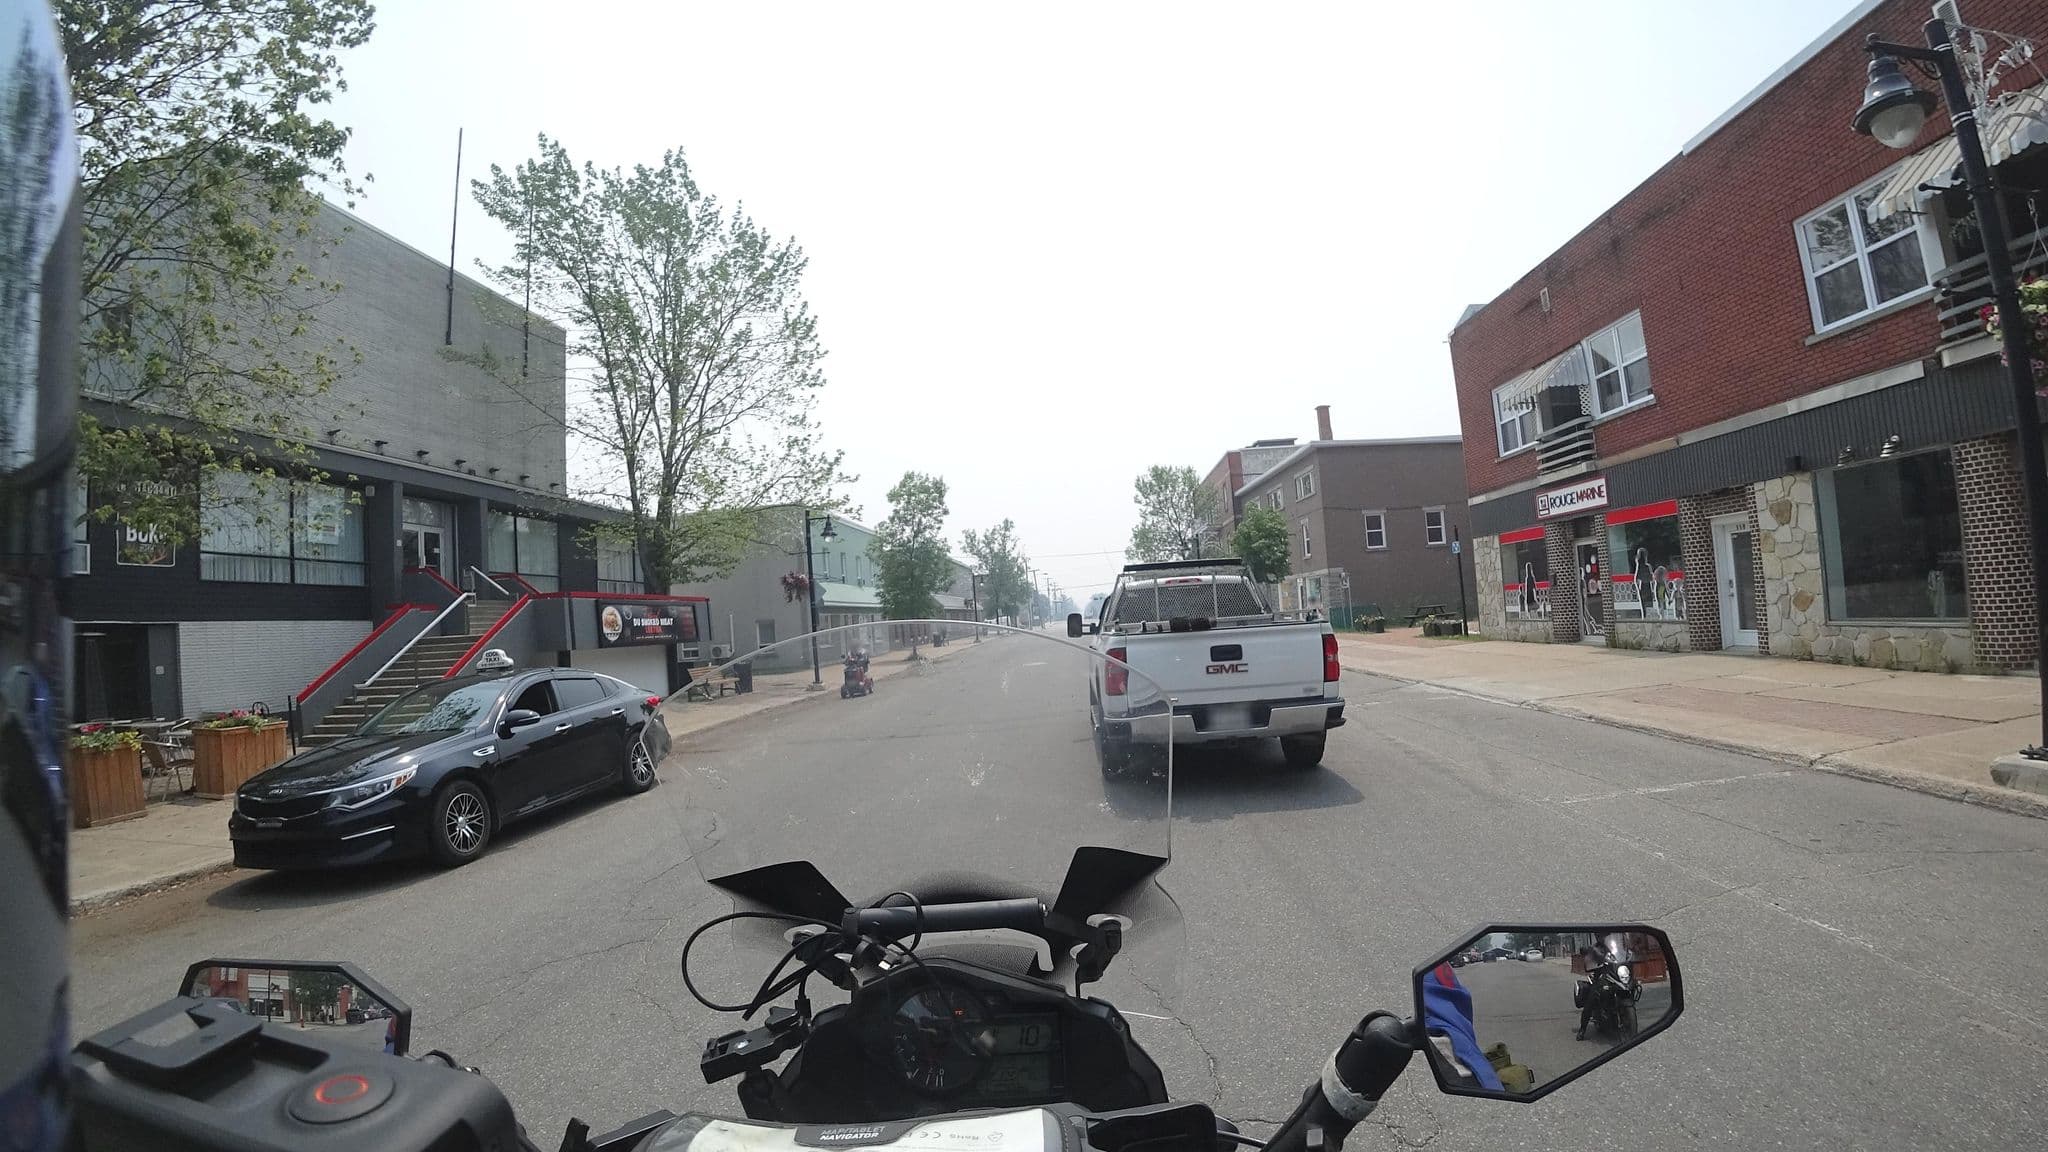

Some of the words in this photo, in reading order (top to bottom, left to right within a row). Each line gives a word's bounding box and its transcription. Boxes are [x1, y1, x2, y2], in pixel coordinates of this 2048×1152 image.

[660, 618, 674, 626] MEAT
[1206, 663, 1249, 675] GMC
[1019, 1024, 1041, 1047] 10
[819, 1132, 879, 1141] NAVIGATOR
